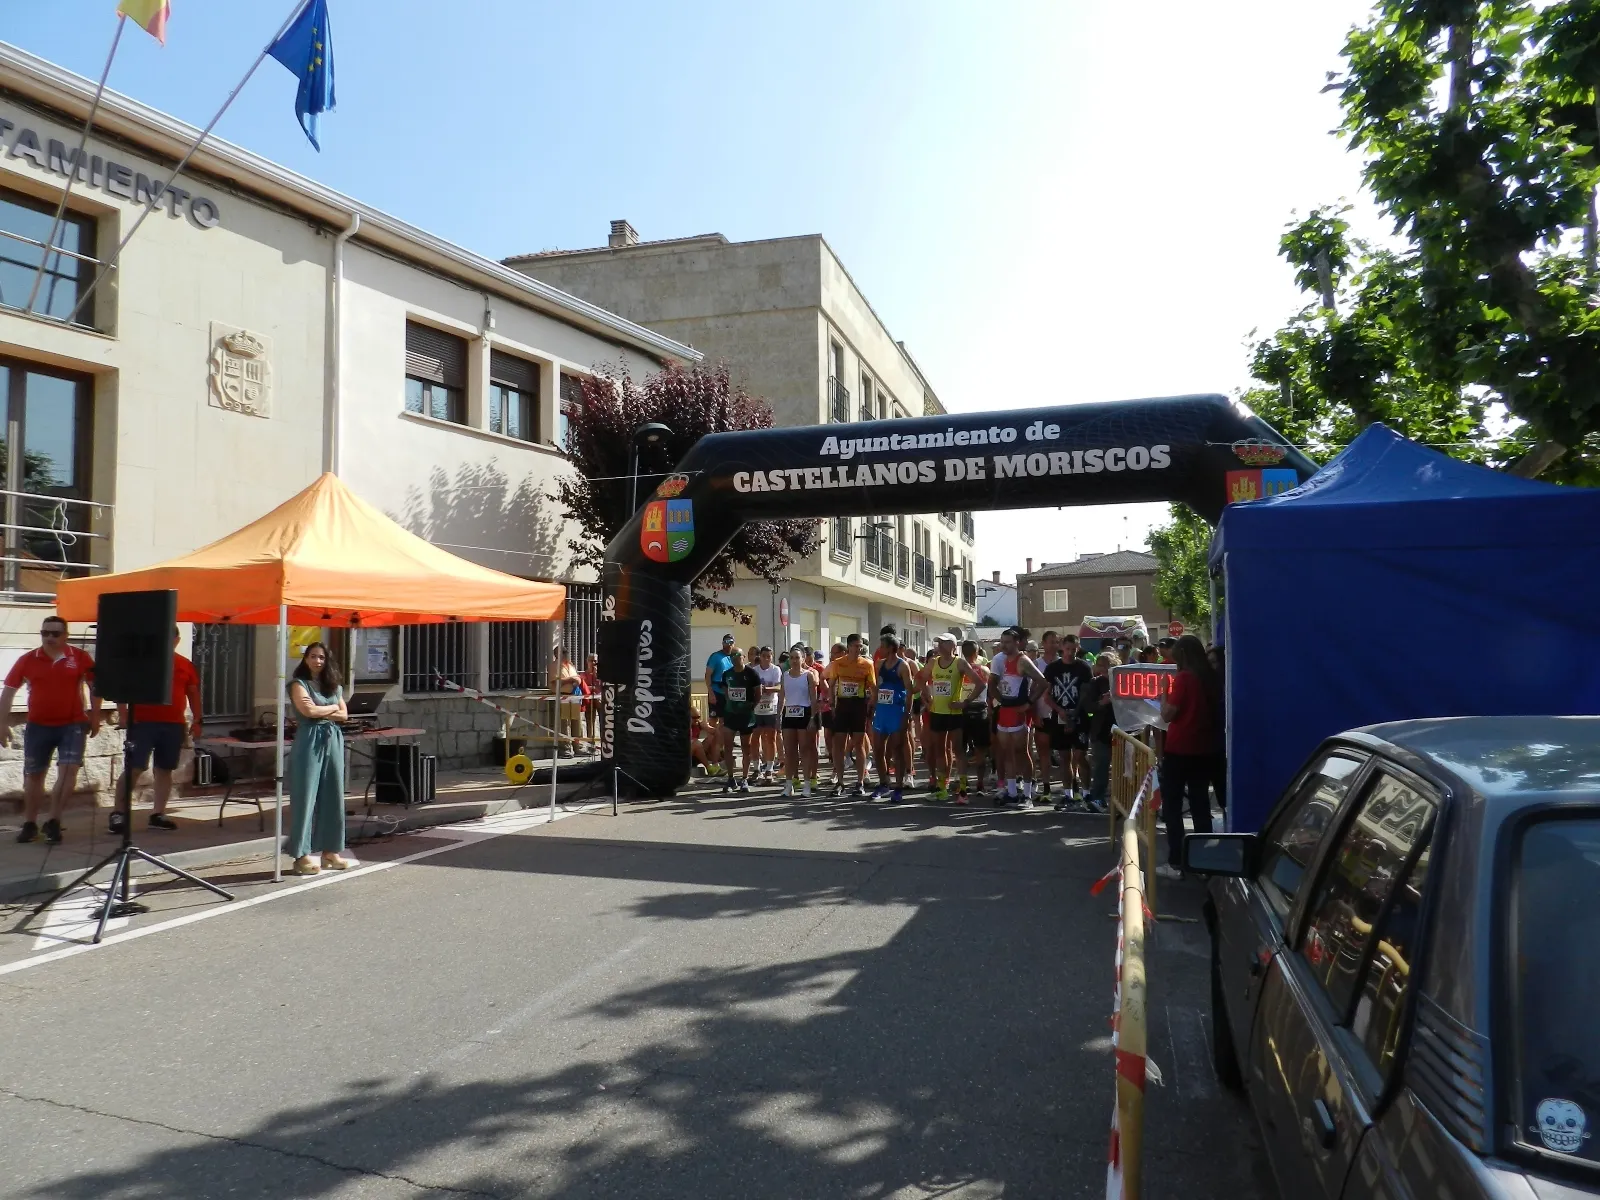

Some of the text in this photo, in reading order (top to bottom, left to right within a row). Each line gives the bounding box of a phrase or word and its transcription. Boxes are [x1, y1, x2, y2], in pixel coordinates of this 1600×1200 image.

[820, 421, 1060, 459] Ayuntamiento de
[733, 445, 1171, 493] CASTELLANOS DE MORISCOS
[627, 619, 666, 735] Deportes
